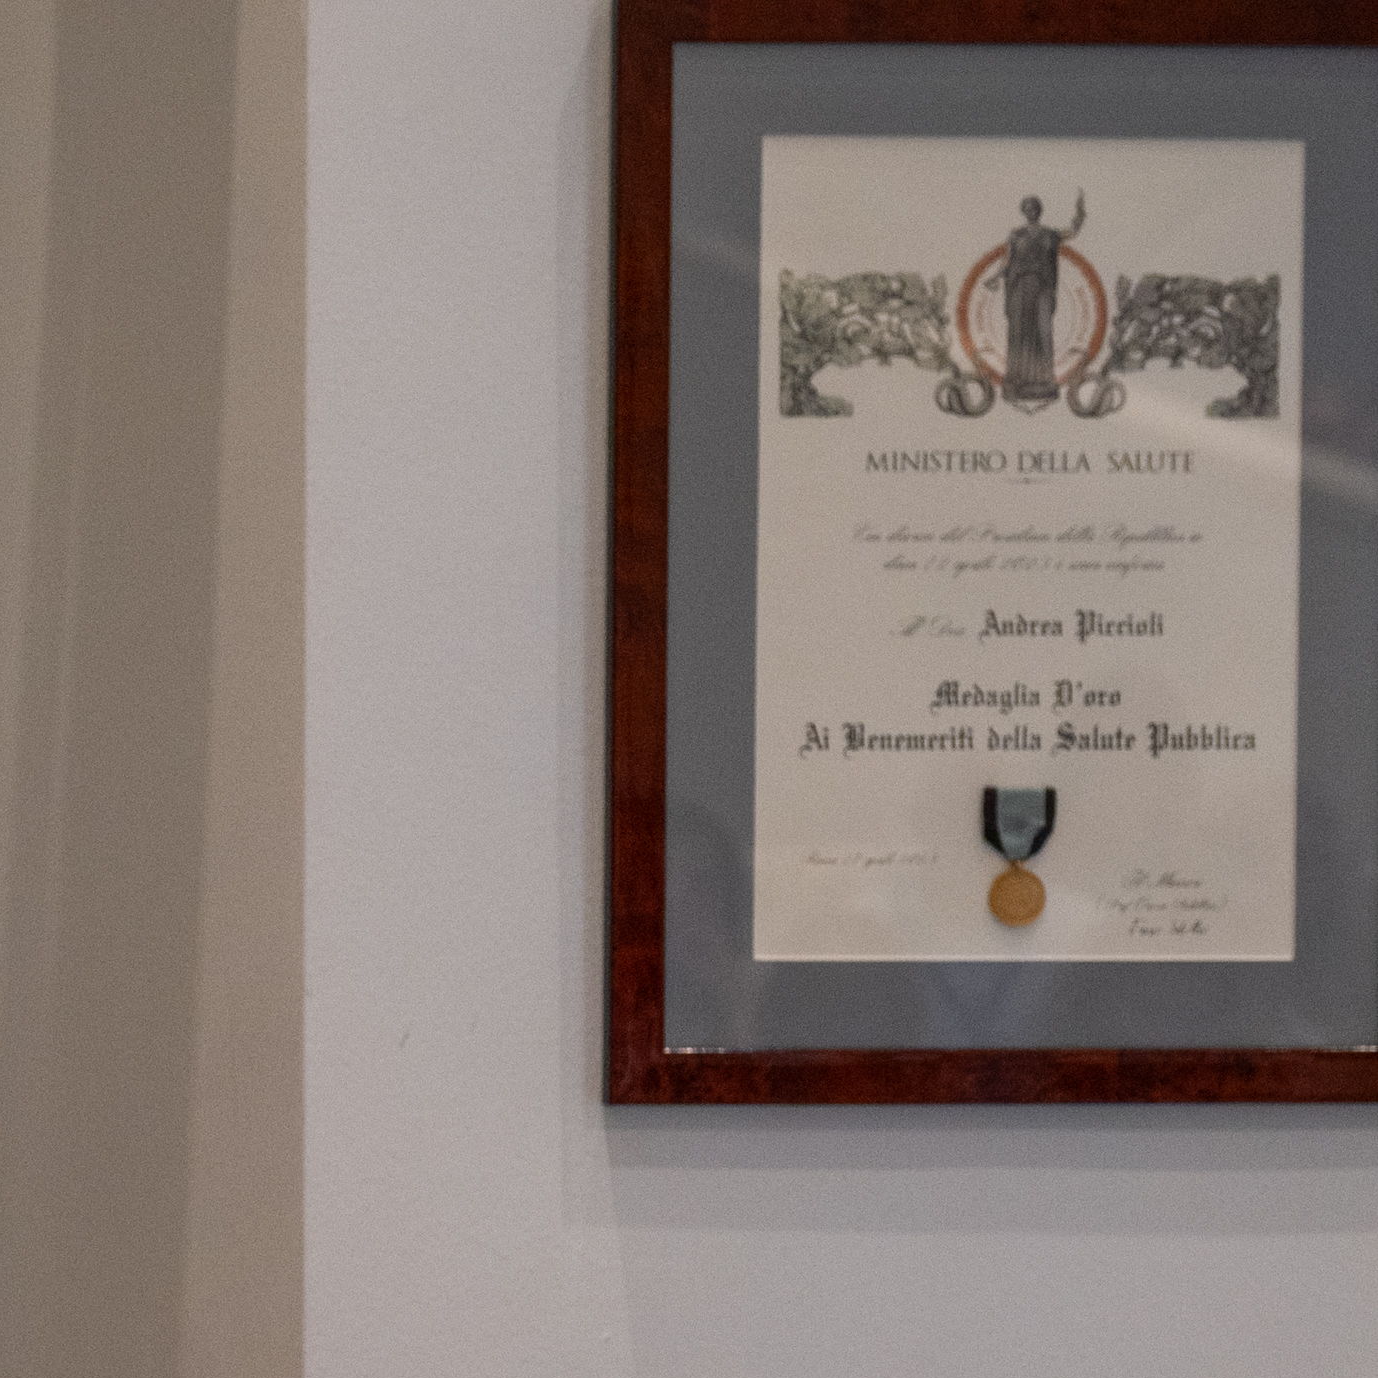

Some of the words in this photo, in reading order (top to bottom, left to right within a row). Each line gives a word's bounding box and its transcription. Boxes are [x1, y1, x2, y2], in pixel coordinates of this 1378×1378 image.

[864, 449, 1008, 474] MINISTERO
[1017, 449, 1091, 474] DELLA
[1106, 449, 1196, 474] SALUTE
